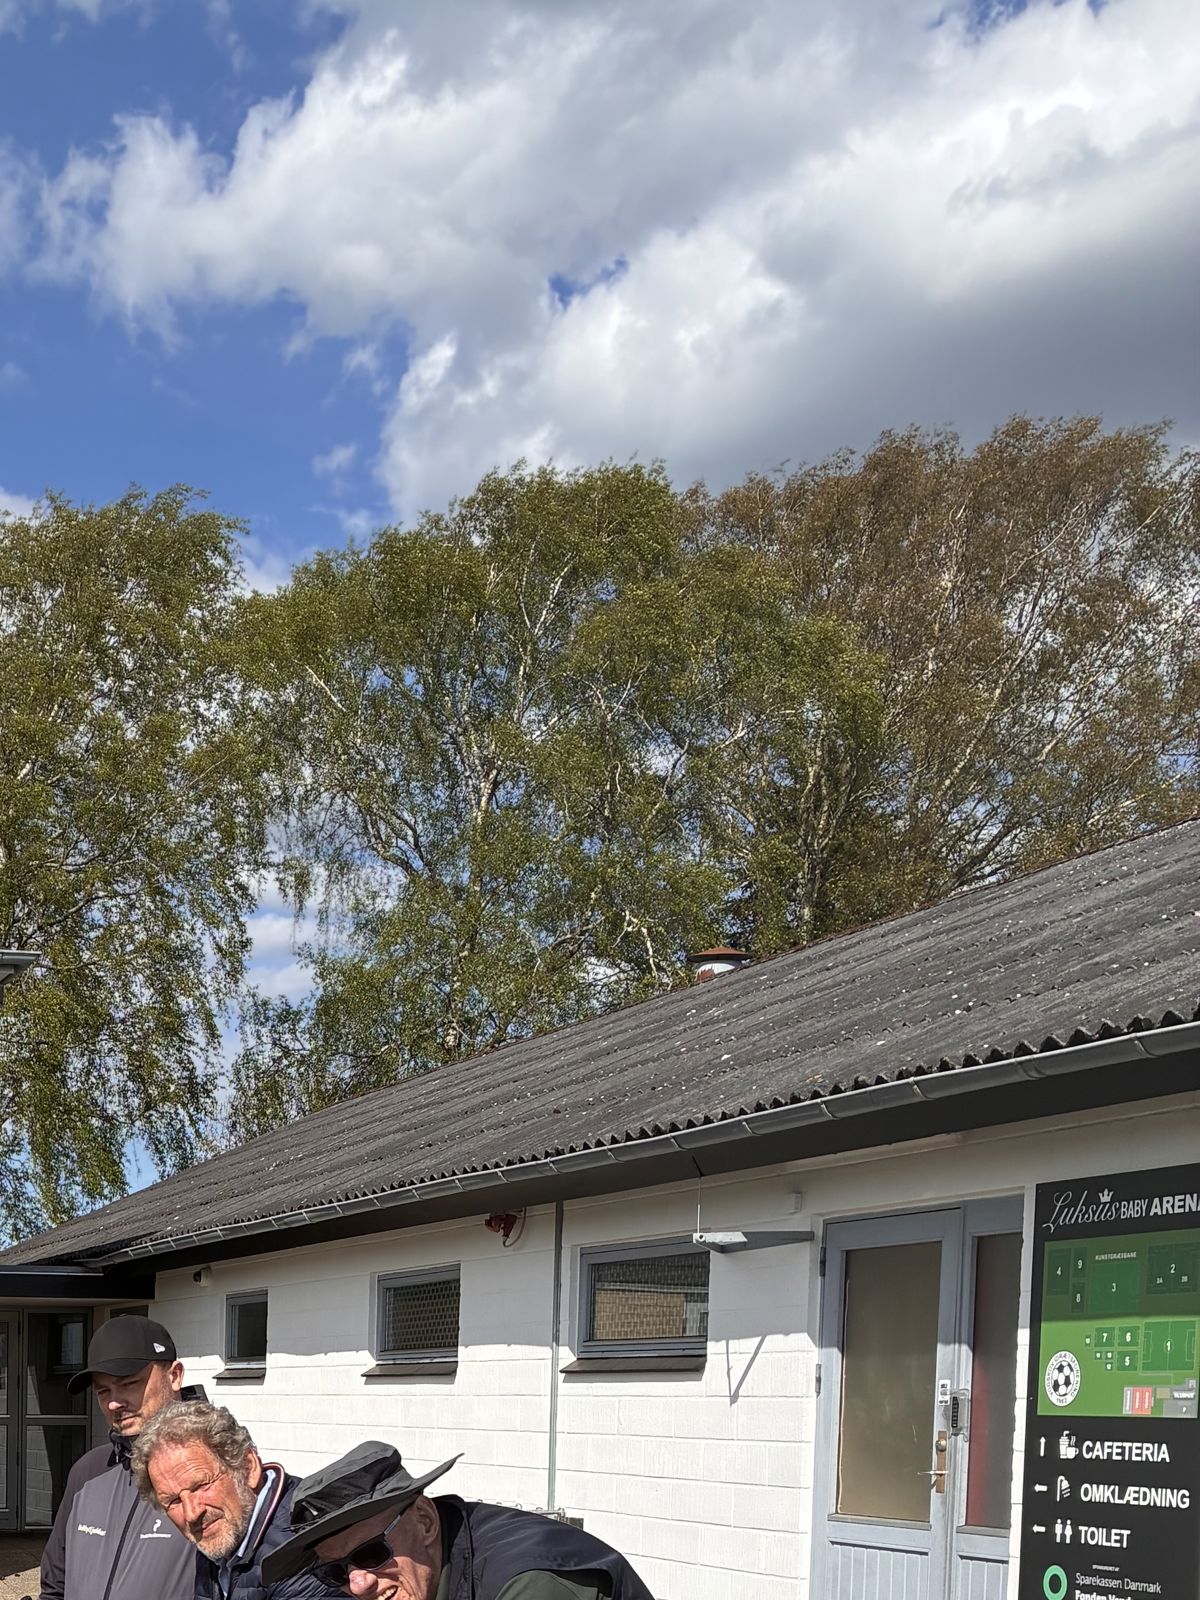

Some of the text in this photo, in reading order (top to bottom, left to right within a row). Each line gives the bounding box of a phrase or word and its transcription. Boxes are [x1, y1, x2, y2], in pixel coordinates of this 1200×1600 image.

[1042, 1190, 1119, 1233] Luksus
[1120, 1199, 1149, 1219] BABY
[1077, 1259, 1082, 1269] 9
[1170, 1263, 1176, 1274] 2
[1056, 1266, 1062, 1276] 4
[1111, 1282, 1117, 1292] 3
[1075, 1293, 1081, 1303] 8
[1102, 1332, 1108, 1343] 7
[1125, 1332, 1132, 1342] 6
[1166, 1340, 1172, 1351] 1
[1124, 1356, 1131, 1366] 5
[1082, 1440, 1170, 1463] CAFETERIA
[1080, 1483, 1190, 1509] OMKLÆDNING
[1078, 1525, 1131, 1548] TOILET
[1075, 1573, 1161, 1594] Sparekassen Danmark
